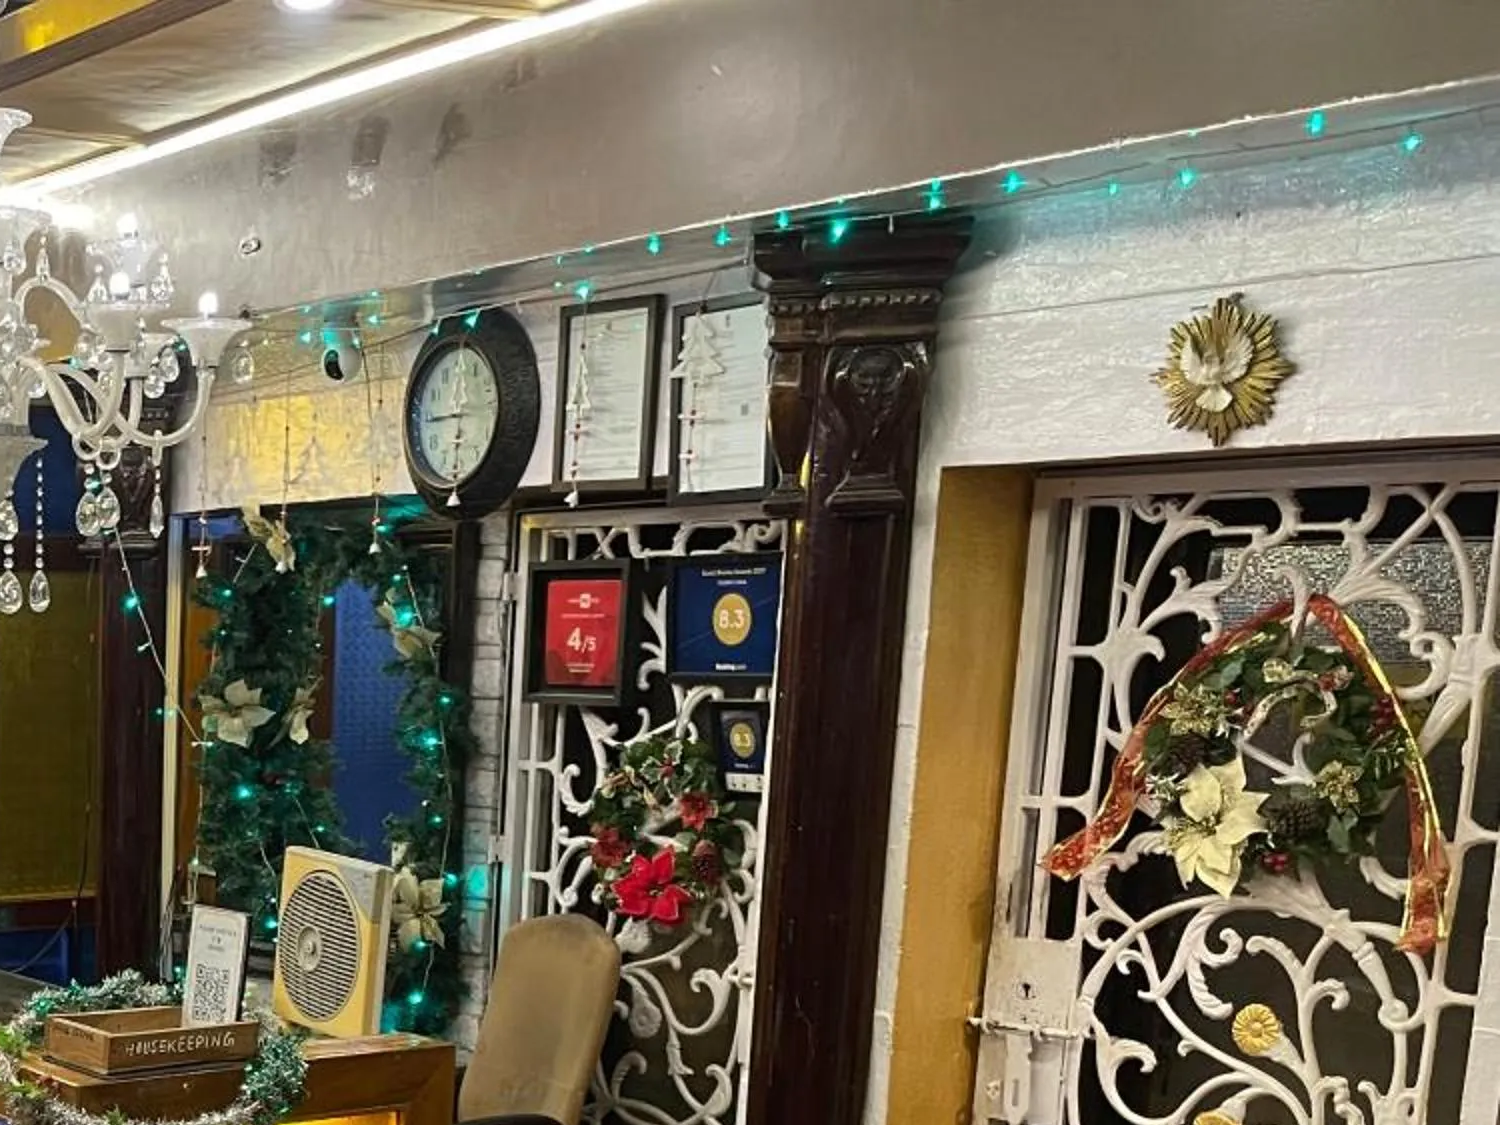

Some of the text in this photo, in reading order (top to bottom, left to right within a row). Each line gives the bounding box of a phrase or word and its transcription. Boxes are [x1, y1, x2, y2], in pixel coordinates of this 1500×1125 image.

[719, 608, 745, 629] 8.3
[566, 626, 597, 654] 4/5
[124, 1031, 236, 1057] HOUSEKEEPING
